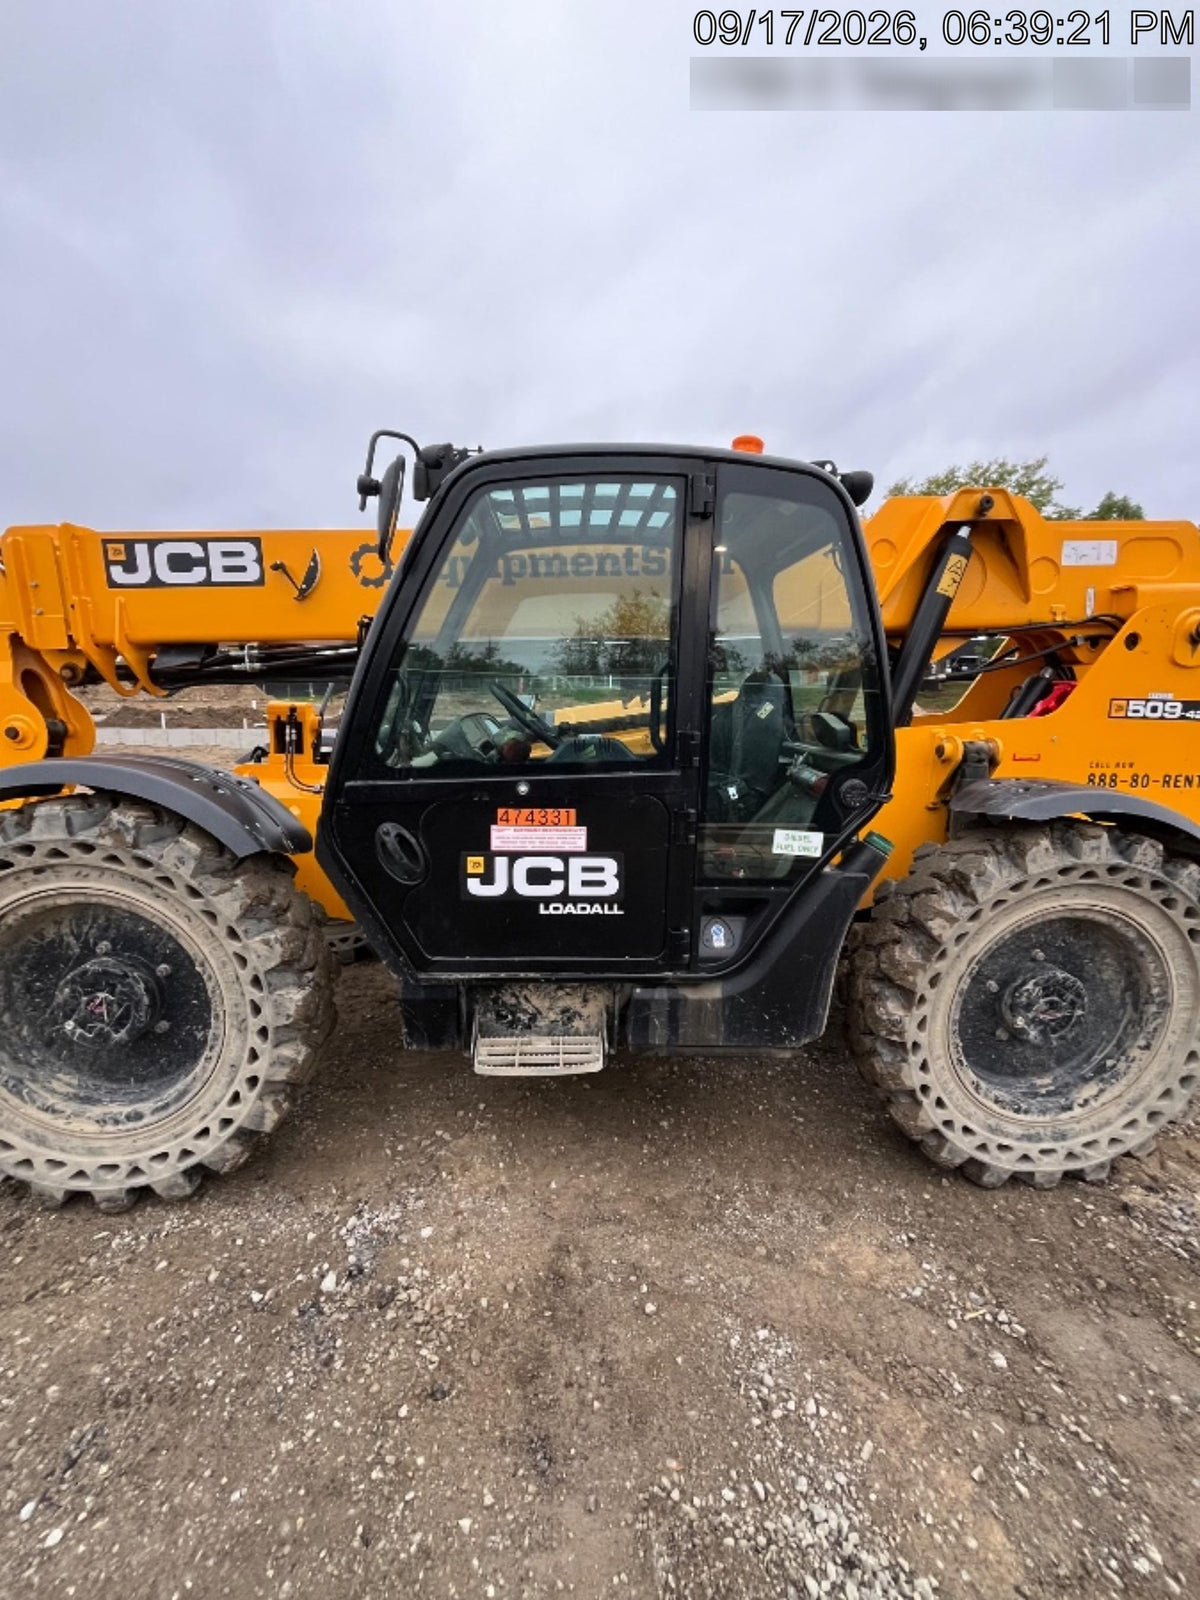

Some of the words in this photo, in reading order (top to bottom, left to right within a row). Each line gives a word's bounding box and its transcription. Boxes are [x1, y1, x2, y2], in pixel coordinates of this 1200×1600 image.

[109, 541, 261, 585] JCB
[499, 809, 571, 825] 474331
[467, 856, 619, 897] JCB
[539, 903, 624, 915] LOADALL
